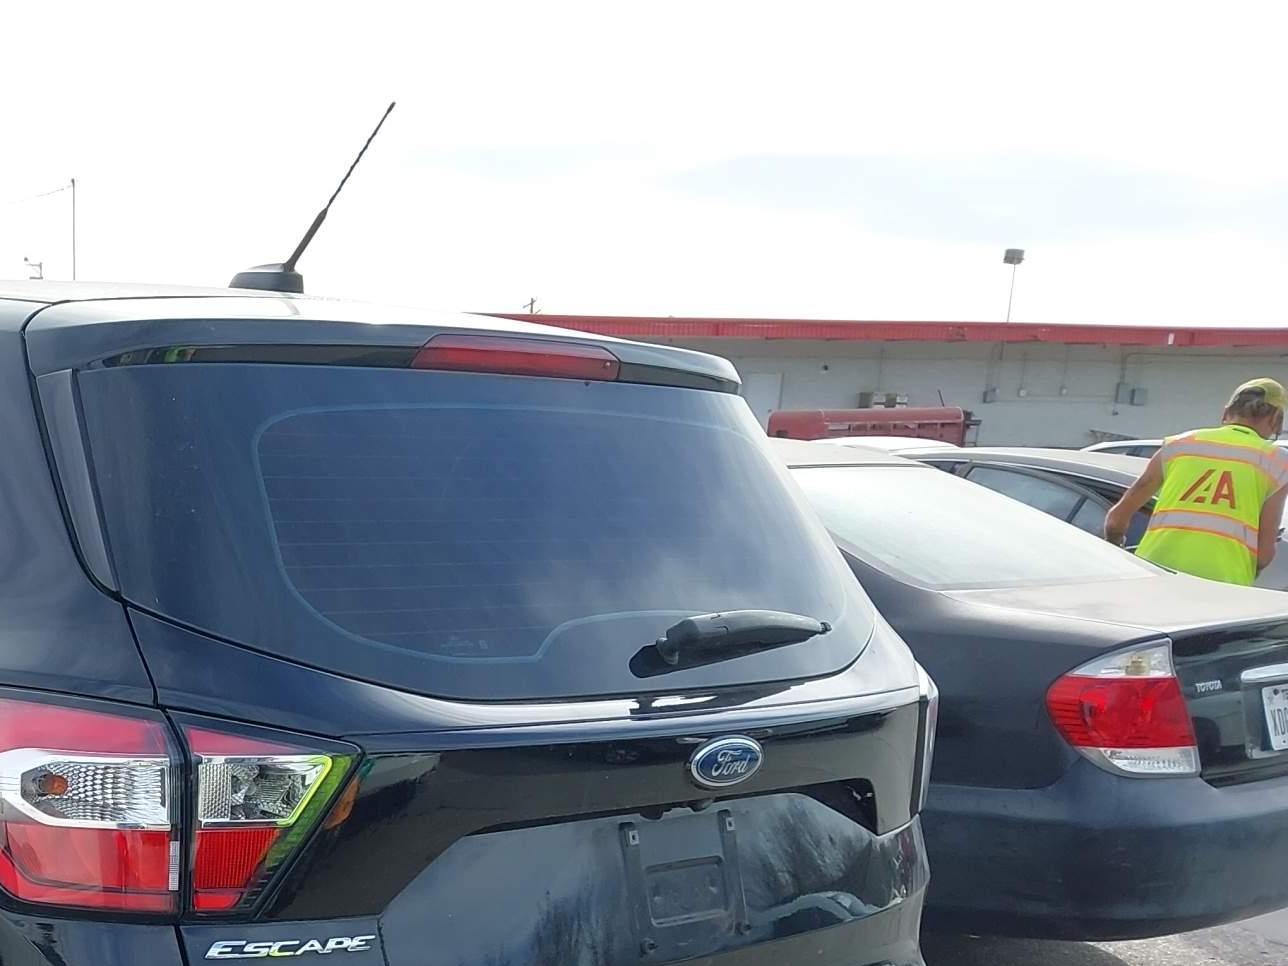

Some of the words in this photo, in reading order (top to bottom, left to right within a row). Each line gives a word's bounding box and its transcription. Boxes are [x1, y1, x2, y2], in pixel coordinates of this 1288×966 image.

[1195, 680, 1222, 693] TOYOTA
[712, 749, 751, 777] Ford
[205, 935, 375, 959] ESCAPE
